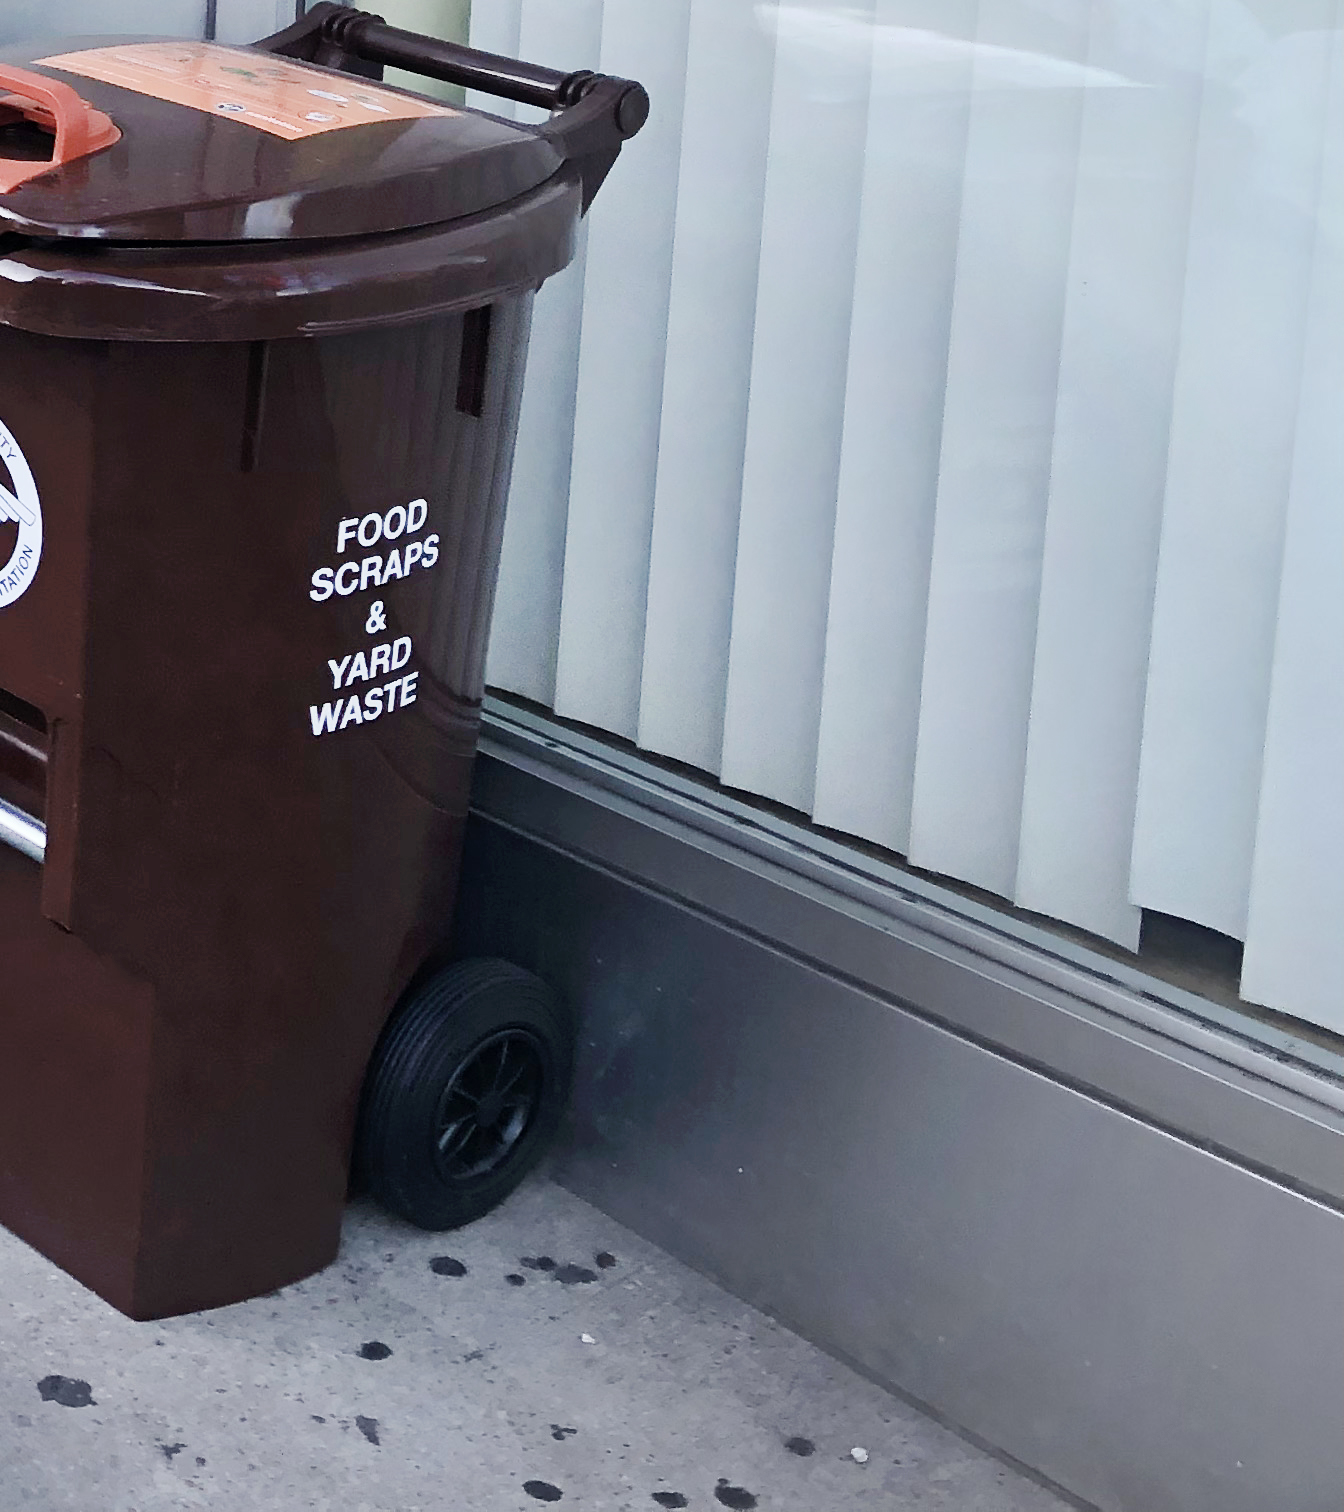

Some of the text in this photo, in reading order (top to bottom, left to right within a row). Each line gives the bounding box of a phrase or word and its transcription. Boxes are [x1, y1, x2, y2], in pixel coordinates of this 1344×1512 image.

[336, 498, 429, 554] FOOD
[309, 533, 440, 602] SCRAPS
[365, 600, 387, 634] &
[328, 635, 413, 690] YARD
[309, 671, 419, 736] WASTE
